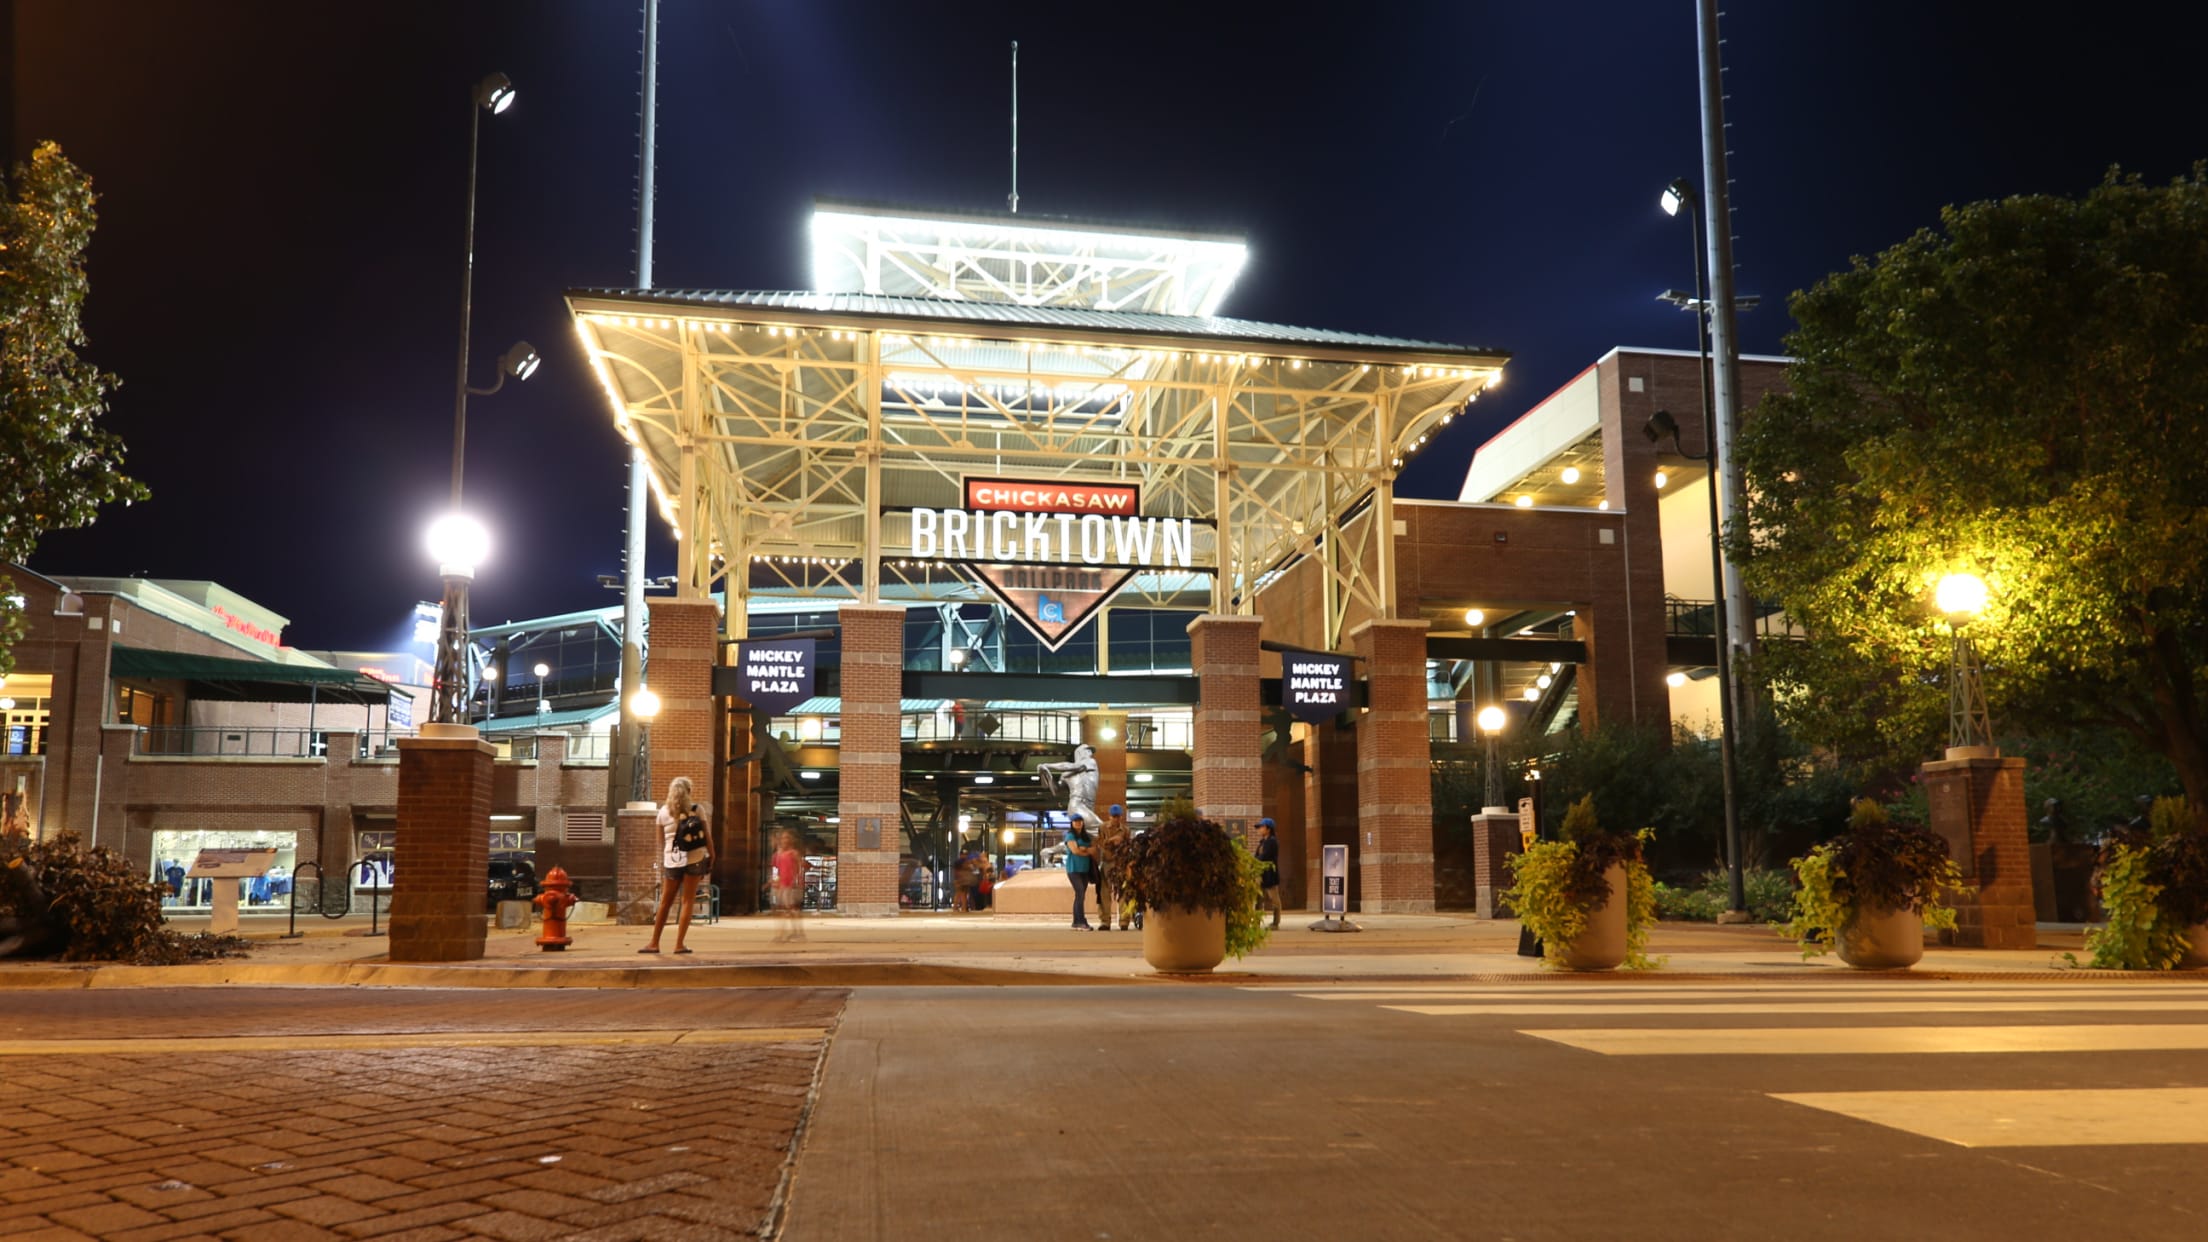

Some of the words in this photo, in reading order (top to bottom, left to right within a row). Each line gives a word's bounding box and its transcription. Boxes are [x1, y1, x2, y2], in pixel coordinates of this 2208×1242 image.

[975, 487, 1128, 510] CHICKASAW
[911, 507, 1192, 567] BRICKTOWN
[749, 650, 803, 662] MICKEY
[746, 665, 805, 677] MANTLE
[1292, 662, 1340, 676] MICKEY
[751, 680, 799, 693] PLAZA
[1290, 677, 1343, 690] MANTLE
[1295, 691, 1336, 704] PLAZA
